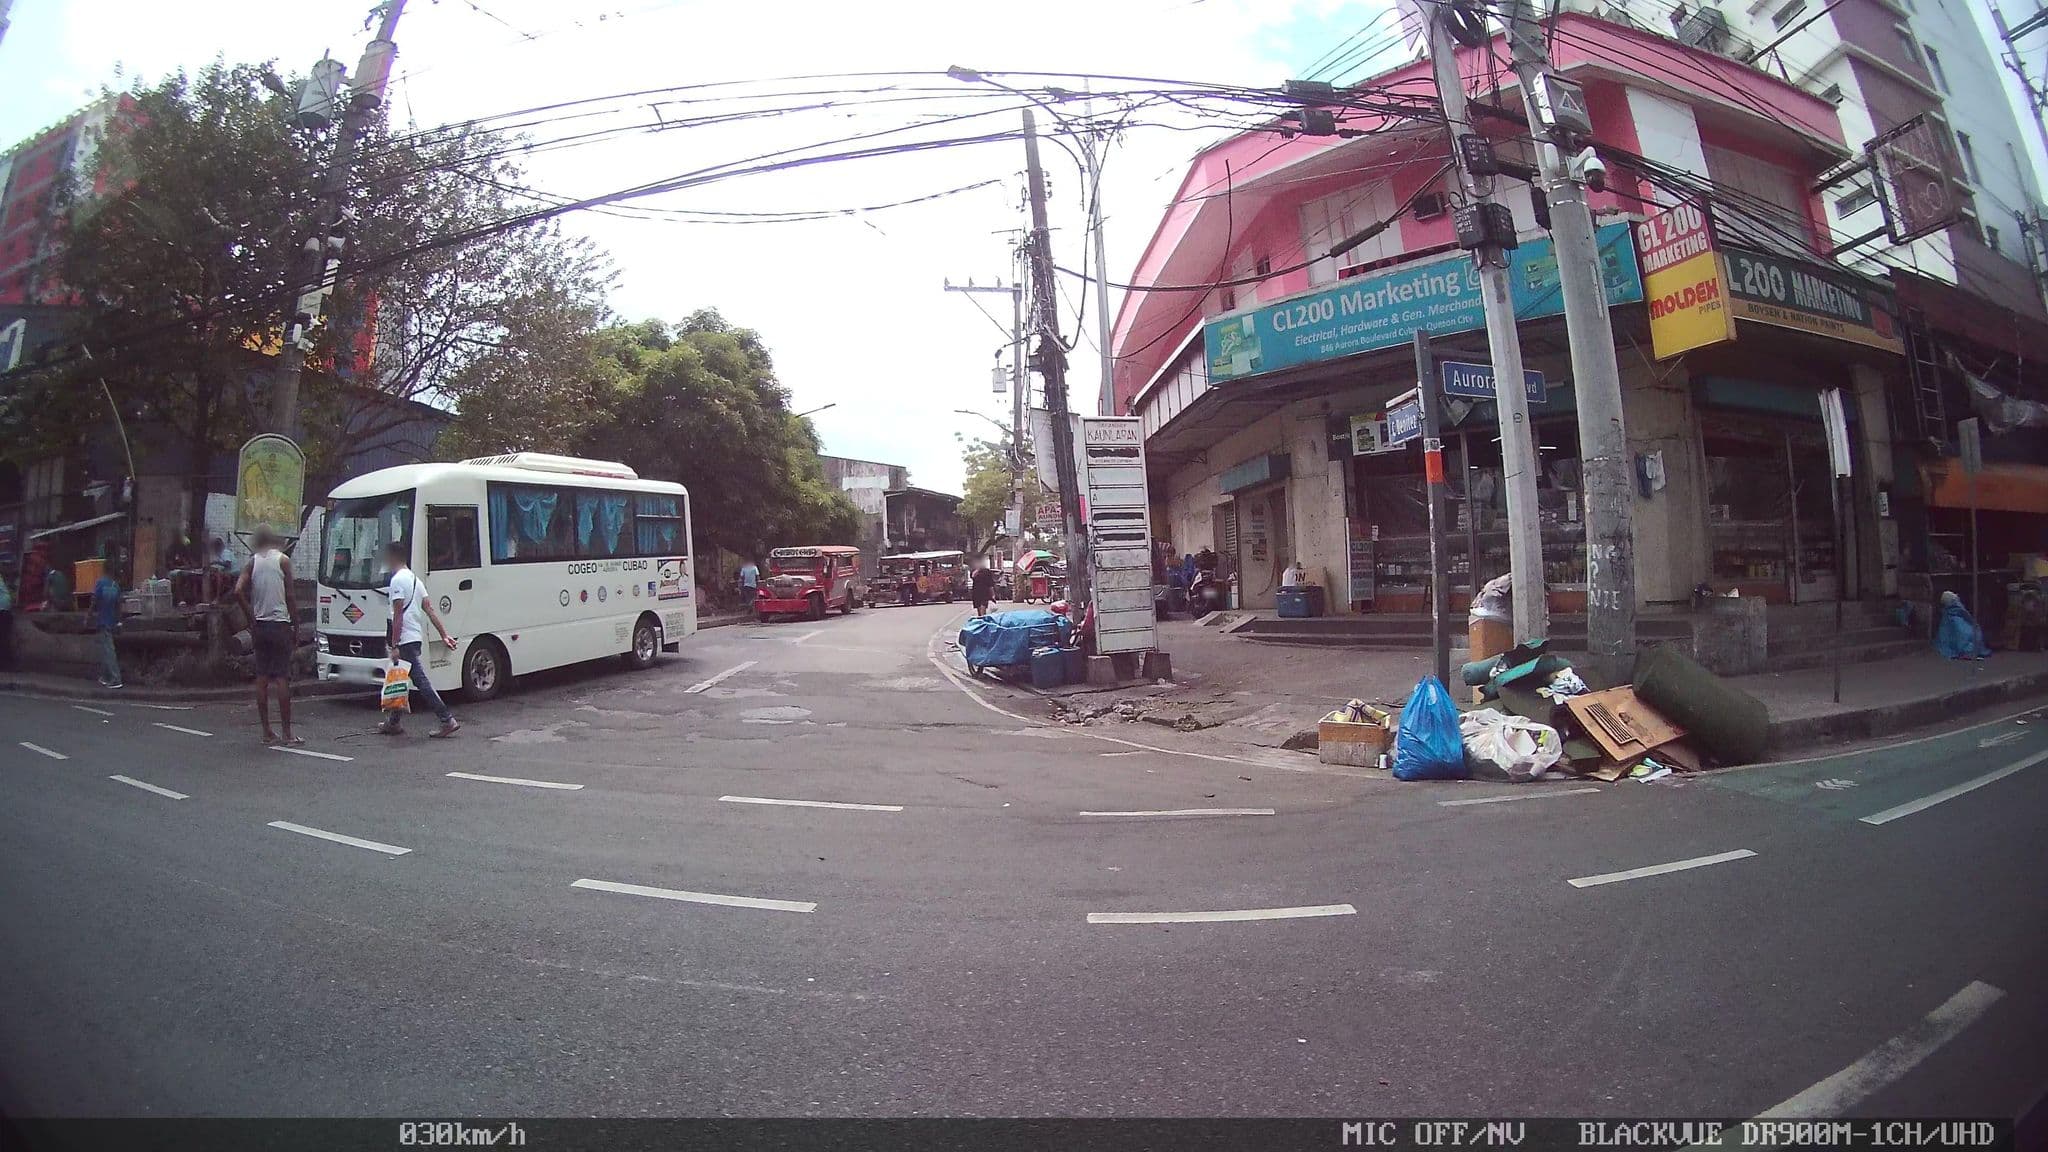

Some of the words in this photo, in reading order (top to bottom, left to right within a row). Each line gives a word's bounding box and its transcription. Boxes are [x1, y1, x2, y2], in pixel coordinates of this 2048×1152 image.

[1638, 220, 1661, 252] CL
[1662, 203, 1701, 241] 200
[1643, 231, 1708, 274] MARKETING
[1723, 254, 1786, 301] L200
[1273, 298, 1335, 332] CL200
[1340, 272, 1461, 316] Marketing
[1651, 278, 1720, 321] MOLDEX
[1698, 300, 1721, 315] PIPES
[1747, 302, 1781, 318] BOYSEN
[1295, 327, 1339, 347] Electrical,
[1340, 317, 1389, 336] Hardware
[1391, 313, 1400, 325] &
[1402, 308, 1425, 321] Gen.
[1428, 294, 1484, 317] Merchand
[1335, 337, 1359, 351] Aurora
[1361, 327, 1397, 345] Boulevard
[1458, 314, 1474, 325] City
[1453, 370, 1497, 390] Aurora
[1526, 382, 1537, 394] vd
[568, 562, 598, 575] COGEO
[622, 560, 648, 571] CUBAO
